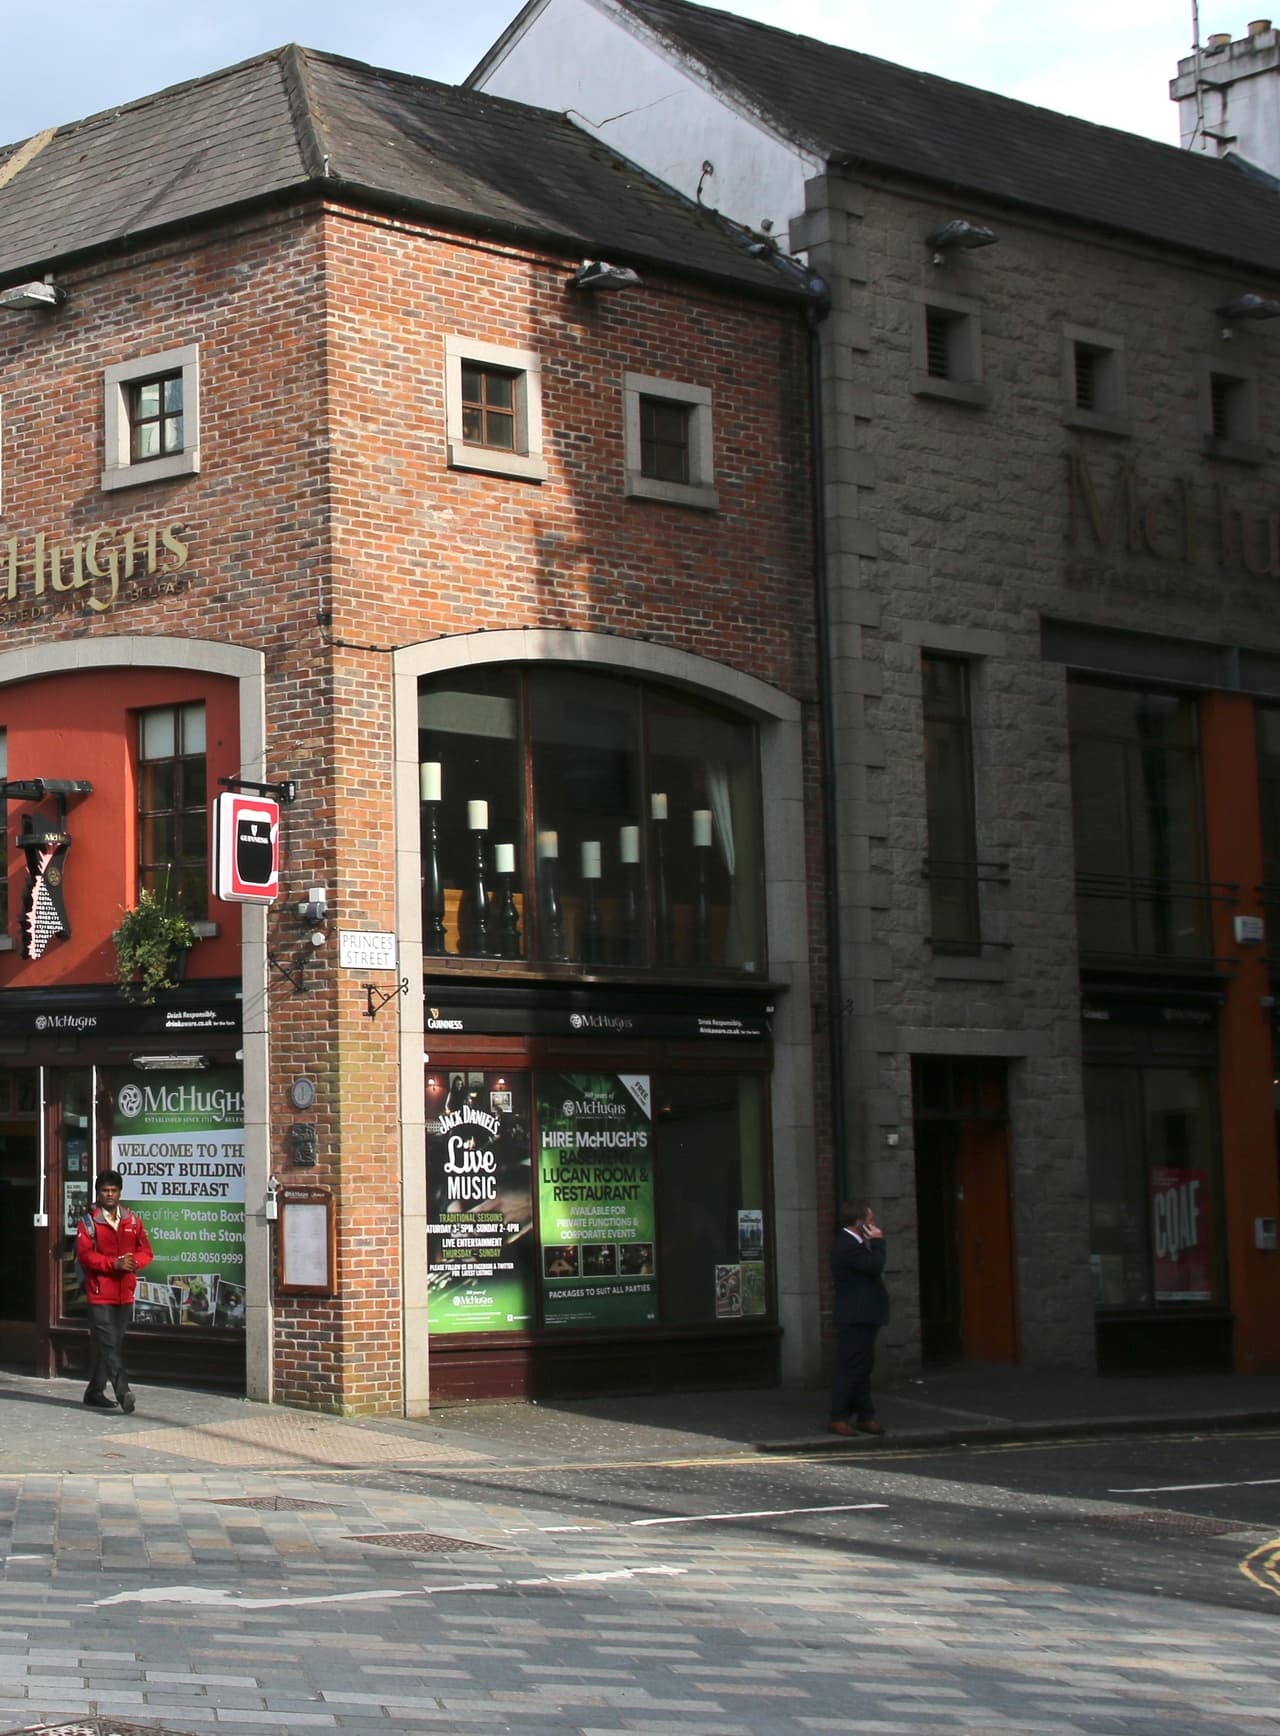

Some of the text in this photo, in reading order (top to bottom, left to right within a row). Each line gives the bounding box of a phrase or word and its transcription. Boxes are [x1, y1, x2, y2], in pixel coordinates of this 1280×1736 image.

[240, 834, 269, 844] GUINNESS
[343, 935, 394, 950] PRINCES
[347, 951, 389, 967] STREET
[427, 1018, 463, 1030] GUINNESS
[438, 1110, 464, 1134] JACK
[542, 1131, 648, 1148] HIRE McHUGH'S
[118, 1143, 193, 1157] WELCOME
[197, 1143, 217, 1157] TO
[444, 1135, 497, 1174] Live
[117, 1162, 245, 1177] OLDEST BUILDIN
[543, 1166, 649, 1184] LUCAN ROOM &
[141, 1181, 229, 1196] IN BELFAST
[448, 1176, 497, 1200] MUSIC
[553, 1185, 640, 1201] RESTAURANT
[128, 1208, 151, 1221] ome
[152, 1207, 161, 1221] of
[163, 1207, 179, 1221] the
[440, 1213, 476, 1222] TRADITIONAL
[570, 1206, 626, 1216] AVAILABLE FOR
[588, 1217, 633, 1227] FUNCTIONS
[1153, 1179, 1200, 1262] CQAF
[183, 1231, 198, 1241] on
[199, 1228, 217, 1241] the
[425, 1224, 452, 1234] ATURDAY
[460, 1224, 473, 1232] 5PM
[476, 1223, 498, 1232] SUNDAY
[507, 1223, 520, 1232] 4PM
[560, 1229, 637, 1240] CORPORATE EVENTS
[442, 1237, 502, 1247] LIVE ENTERTAINMENT
[181, 1252, 197, 1263] 028
[198, 1252, 220, 1264] 9050
[221, 1252, 243, 1264] 9999
[443, 1248, 472, 1257] THURSDAY
[479, 1248, 501, 1257] SUNDAY
[548, 1284, 651, 1299] PACKAGES TO SUIT ALL PARTIES
